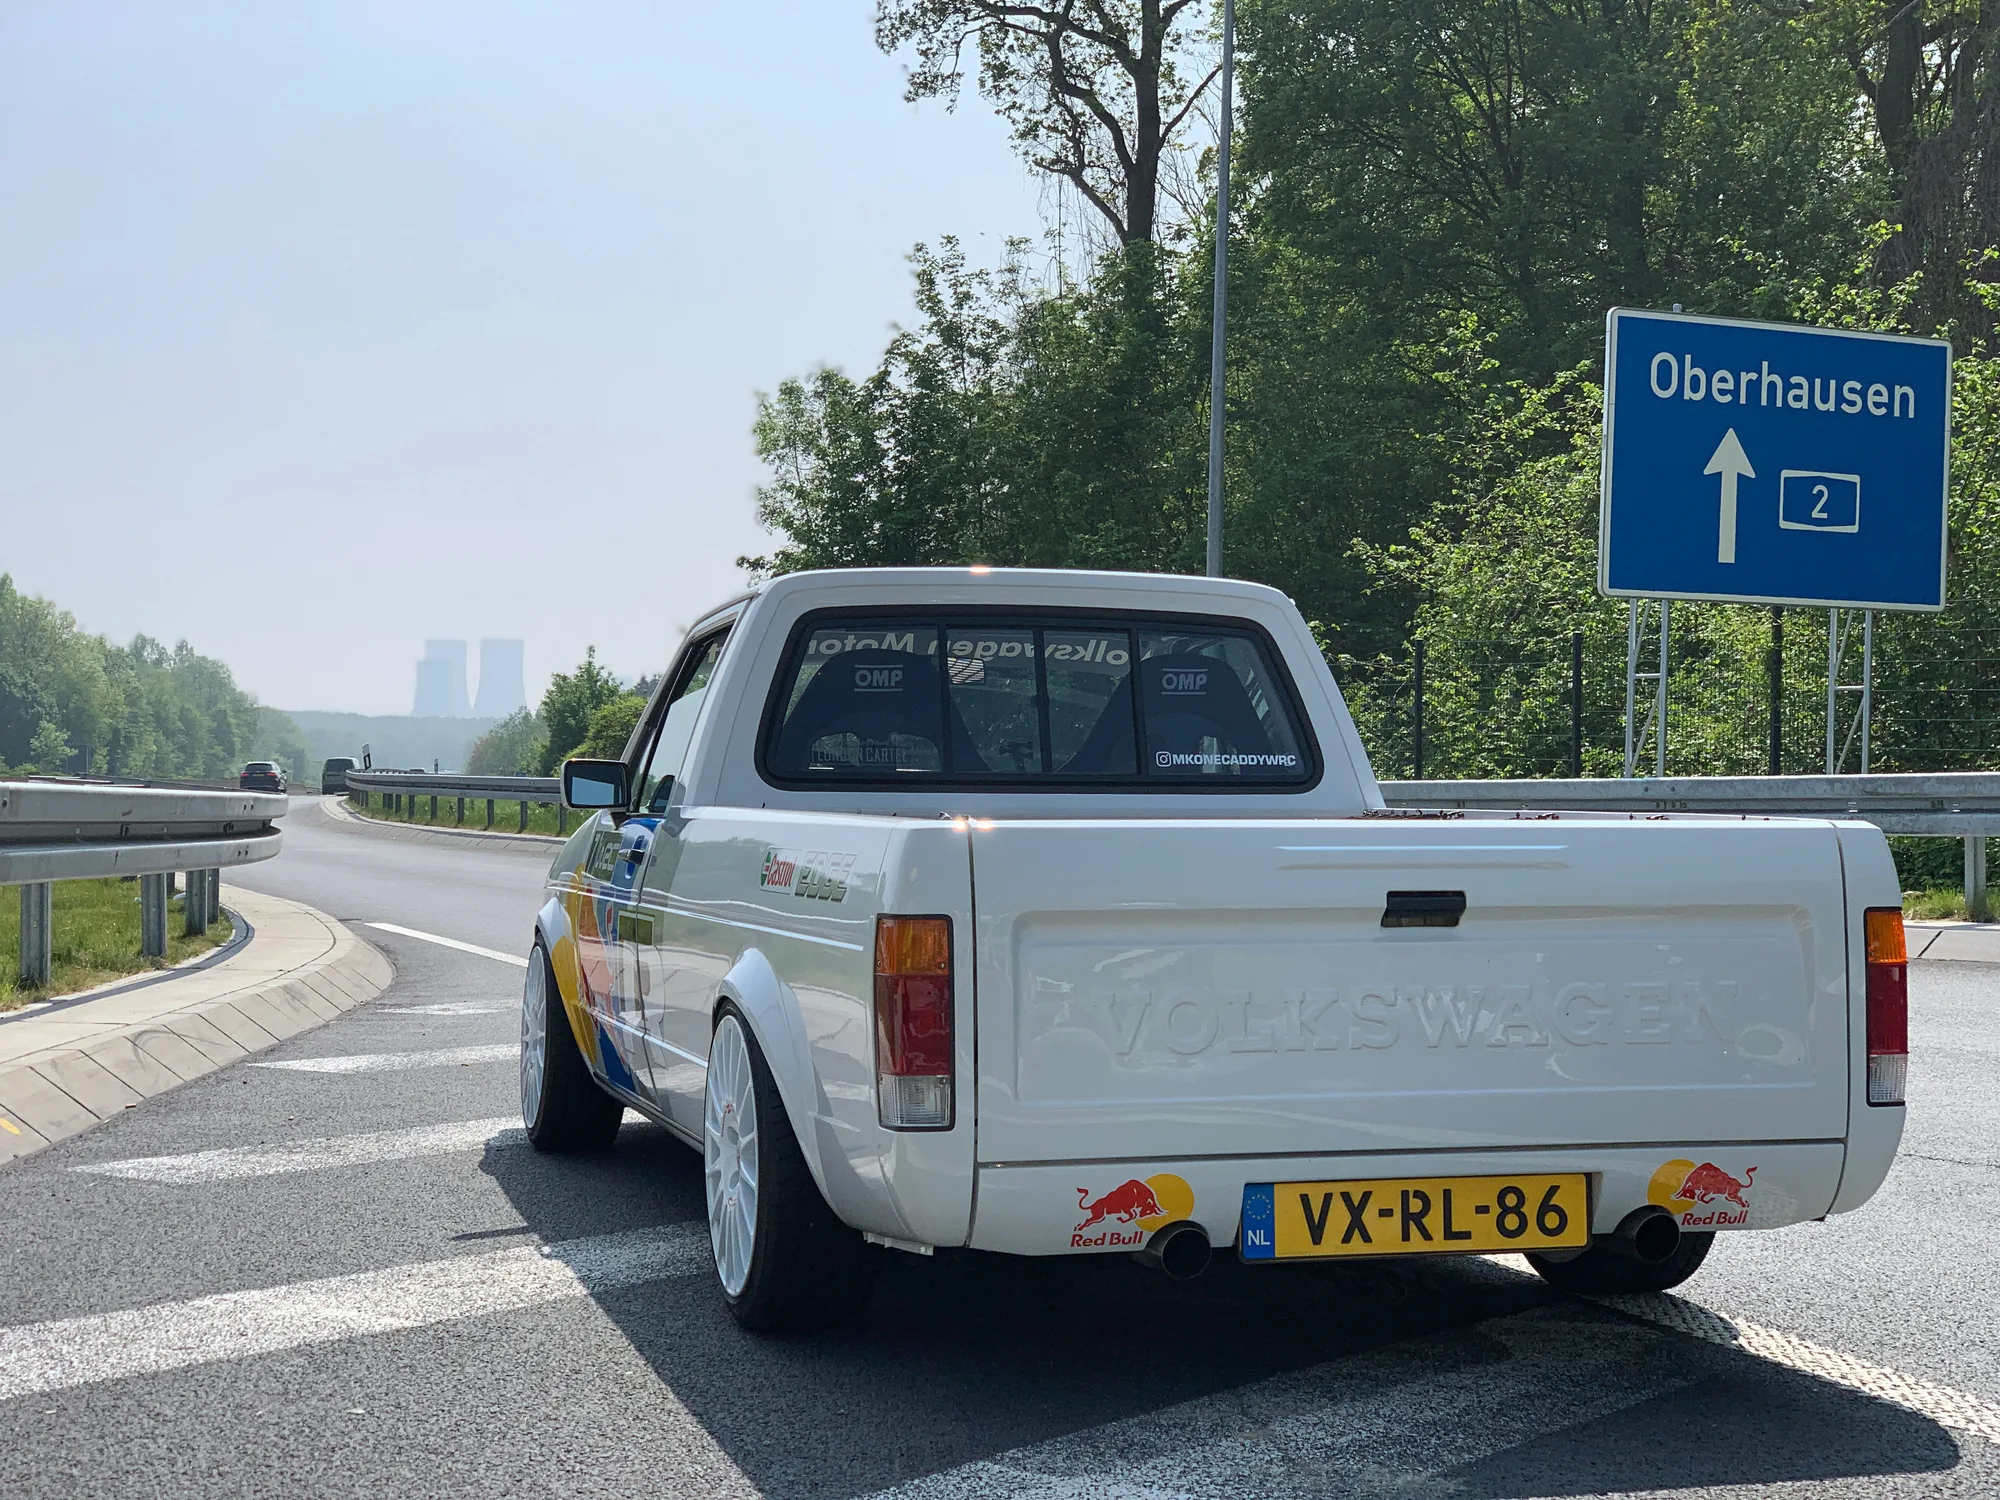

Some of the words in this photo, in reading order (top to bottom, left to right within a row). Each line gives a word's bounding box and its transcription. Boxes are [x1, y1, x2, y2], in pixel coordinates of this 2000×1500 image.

[1650, 352, 1915, 418] Oberhausen
[1811, 484, 1829, 519] 2
[855, 669, 903, 687] OMP
[1161, 673, 1207, 690] OMP
[1172, 753, 1296, 766] MKONECADDYWRC
[767, 852, 798, 888] Castrol
[1093, 981, 1745, 1057] VOLKSWAGEN
[1300, 1184, 1569, 1246] VX-RL-86
[1681, 1212, 1716, 1226] Red
[1716, 1210, 1748, 1225] Bull
[1070, 1232, 1107, 1248] Red
[1109, 1231, 1144, 1246] Bull
[1247, 1230, 1271, 1246] NL
